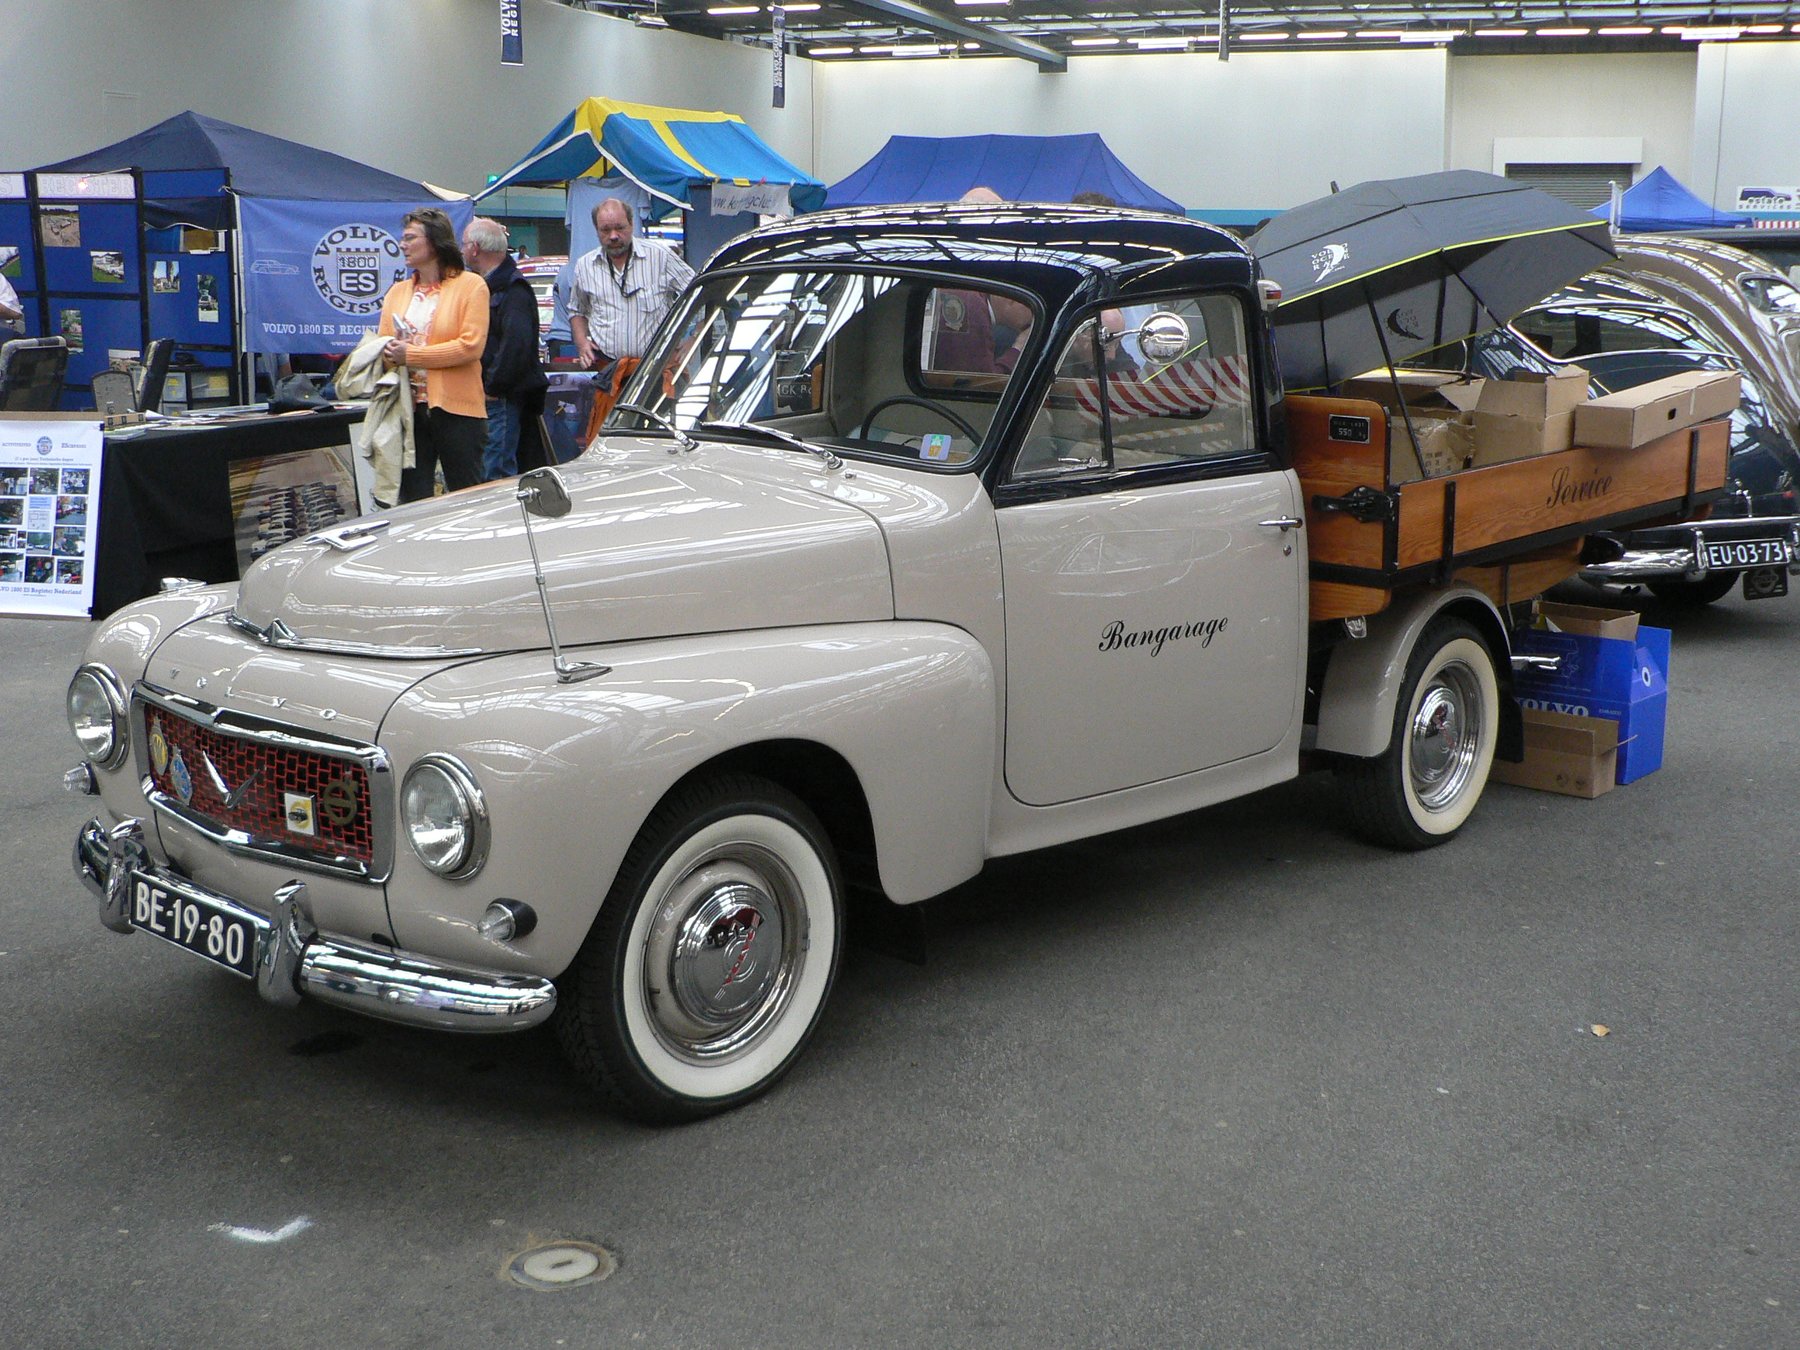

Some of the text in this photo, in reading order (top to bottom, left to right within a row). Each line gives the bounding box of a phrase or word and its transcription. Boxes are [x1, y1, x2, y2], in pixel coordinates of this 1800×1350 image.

[314, 226, 401, 257] VOLVO
[340, 256, 377, 268] 1800
[313, 266, 406, 314] REGISTR
[341, 272, 376, 292] ES
[262, 323, 296, 334] VOLVO
[299, 324, 320, 335] 1800
[322, 324, 335, 335] ES
[1546, 466, 1612, 509] Service
[1708, 542, 1783, 566] EU-03-73
[1099, 617, 1229, 658] Bangarage
[136, 881, 245, 965] BE-19-80
